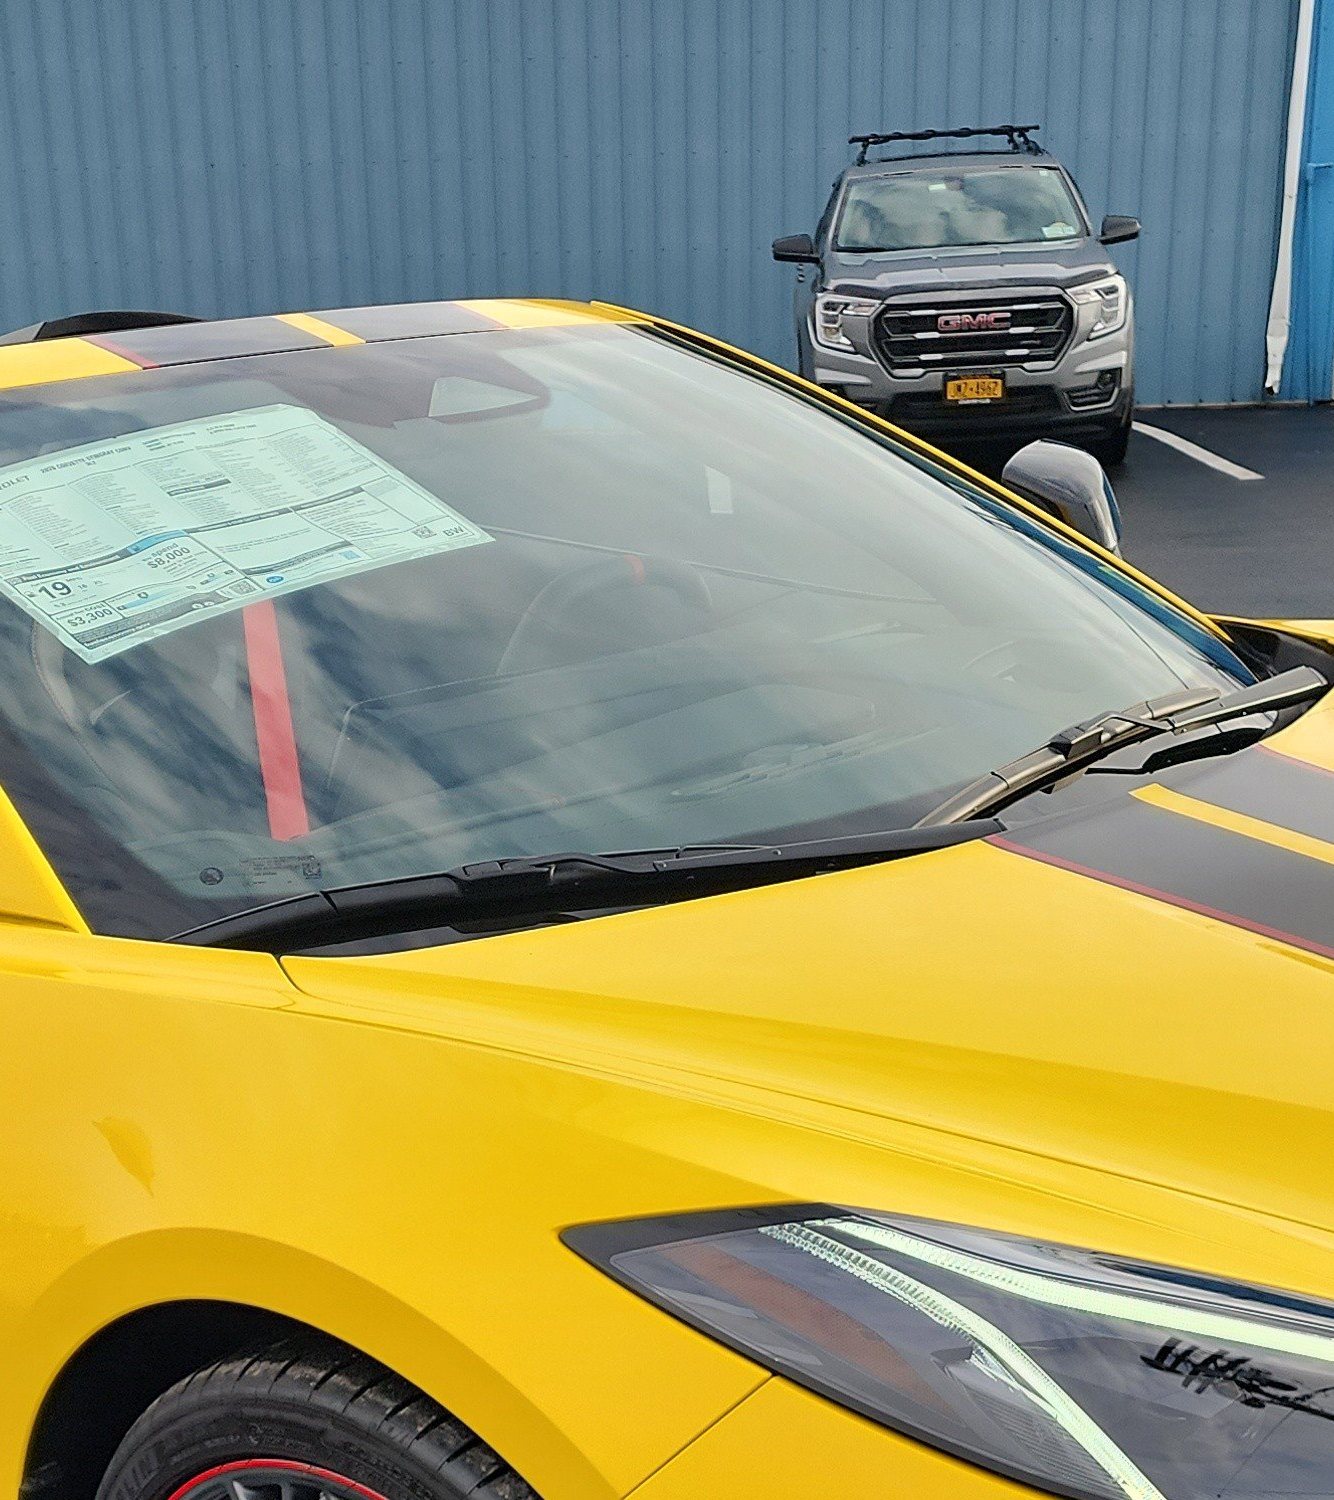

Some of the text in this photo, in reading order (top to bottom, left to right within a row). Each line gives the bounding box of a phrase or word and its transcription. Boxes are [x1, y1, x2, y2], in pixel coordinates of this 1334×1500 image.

[937, 312, 1012, 332] GMC
[147, 546, 191, 570] $8,000
[38, 580, 73, 600] 19
[67, 607, 114, 627] $3,300
